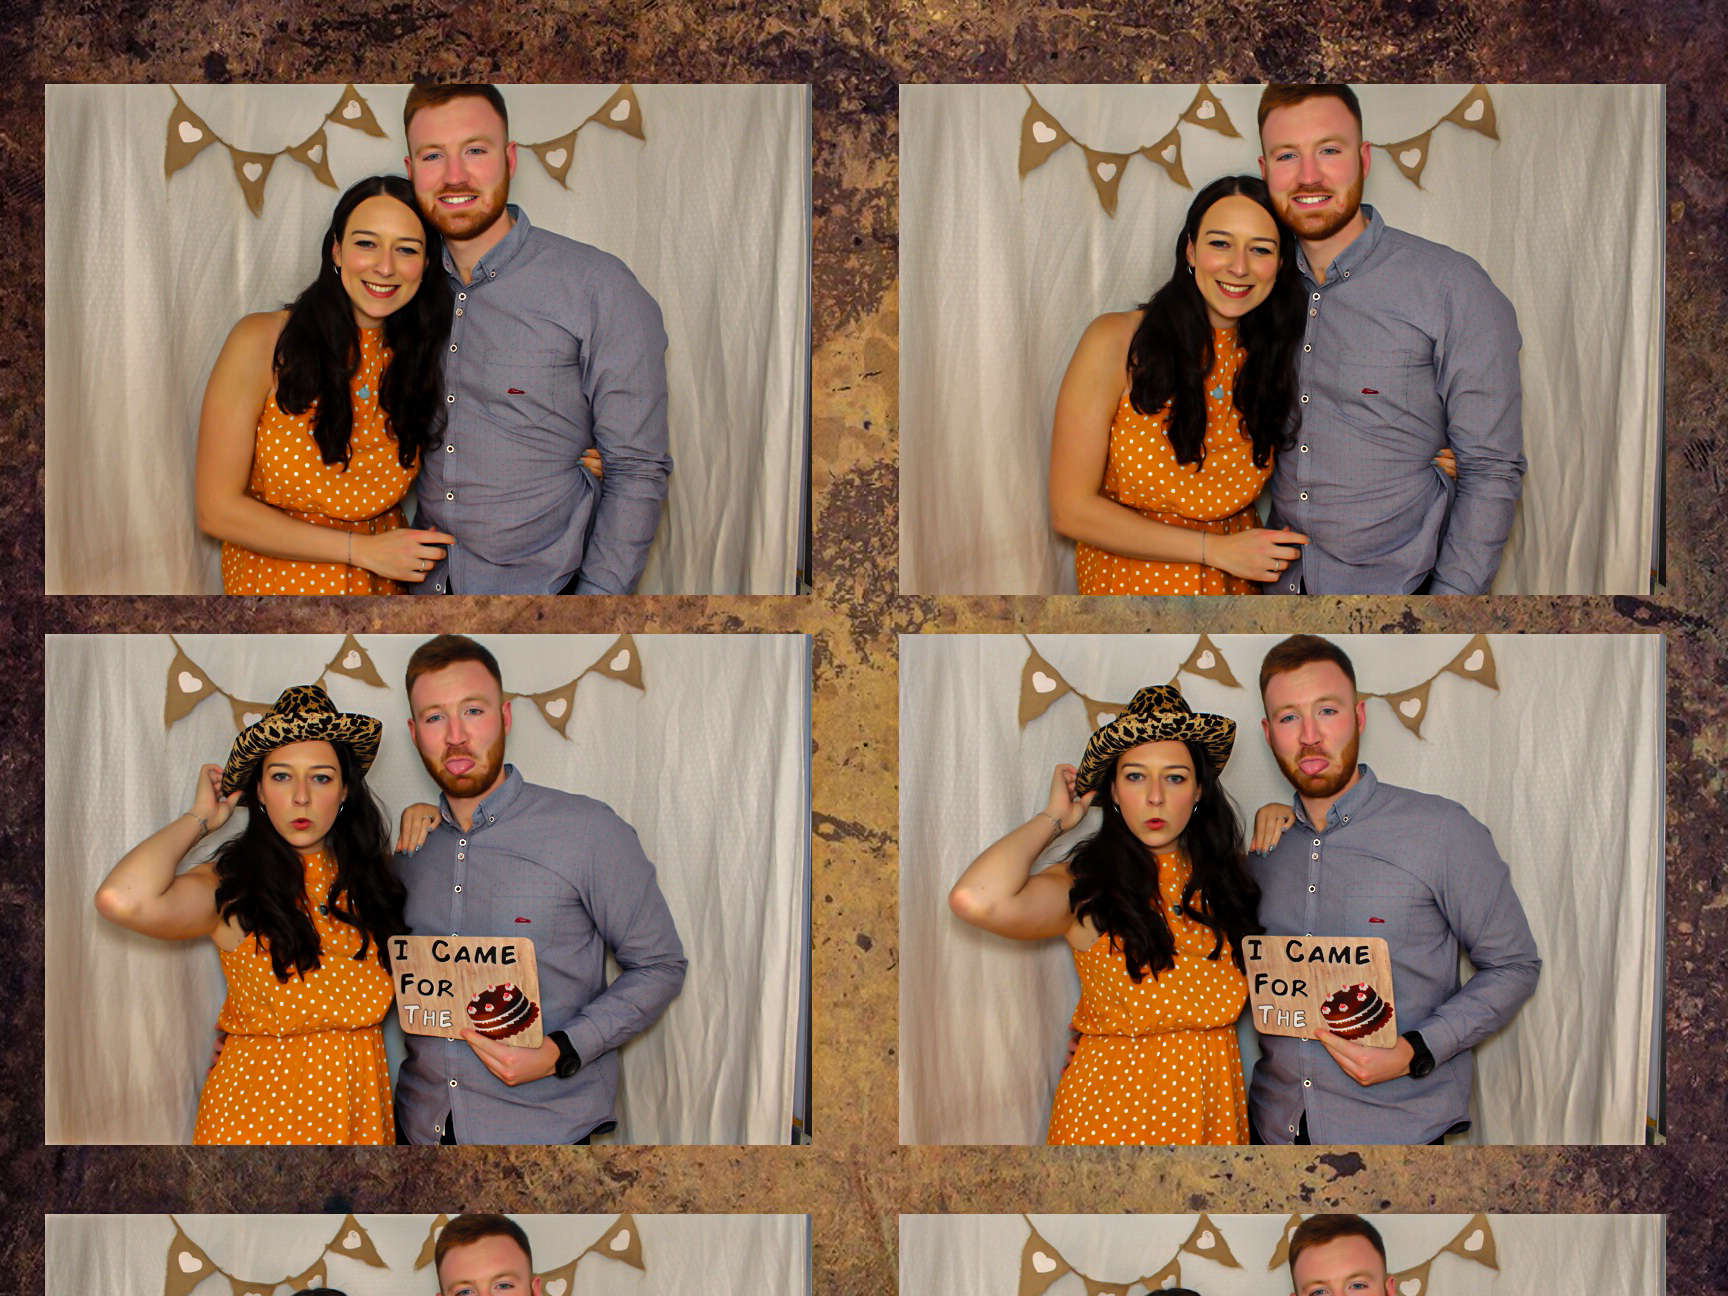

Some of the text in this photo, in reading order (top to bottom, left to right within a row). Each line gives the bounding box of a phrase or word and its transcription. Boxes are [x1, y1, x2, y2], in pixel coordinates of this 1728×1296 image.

[394, 940, 517, 965] I CAME
[1248, 940, 1371, 965] I CAME
[401, 973, 454, 998] FOR
[1255, 973, 1308, 998] FOR
[404, 1004, 453, 1028] THE
[1258, 1004, 1307, 1028] THE
